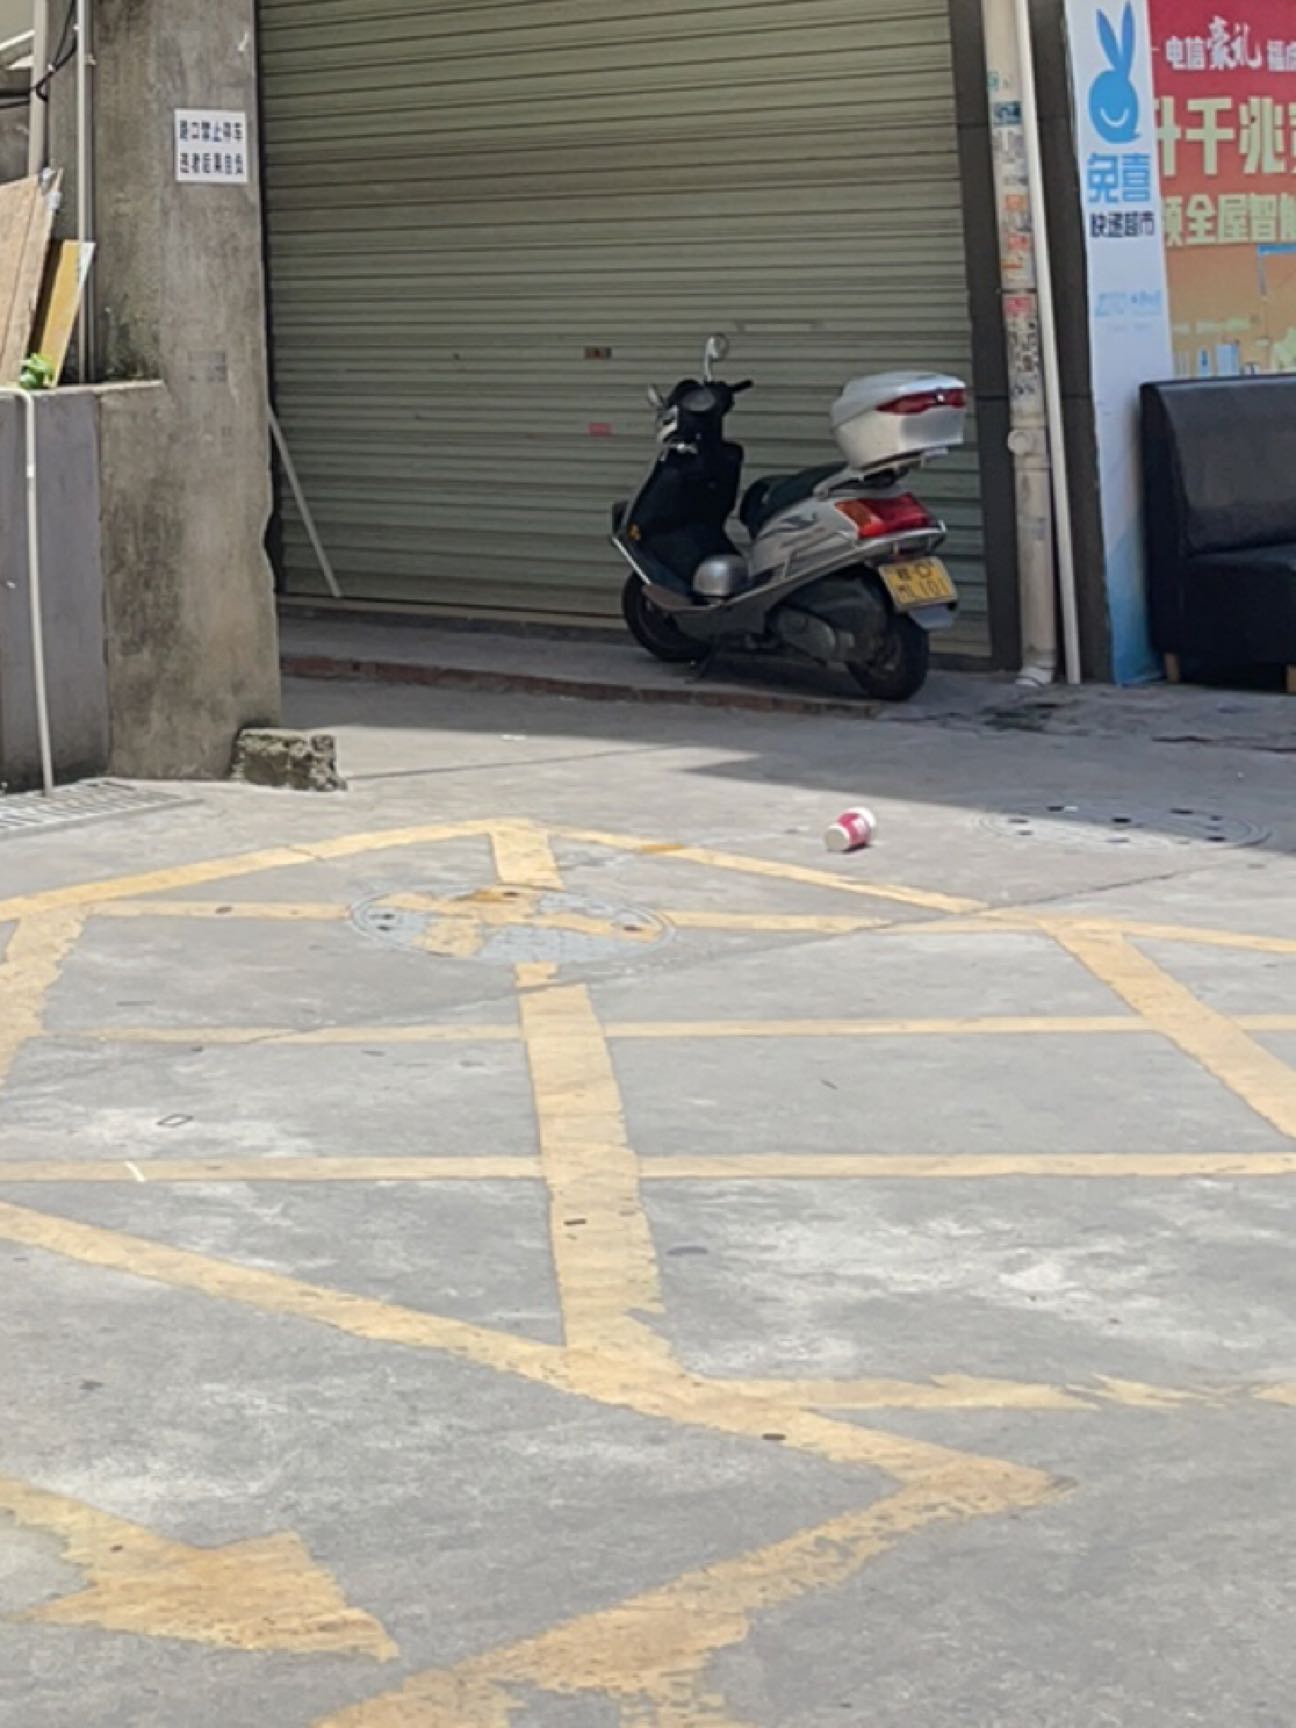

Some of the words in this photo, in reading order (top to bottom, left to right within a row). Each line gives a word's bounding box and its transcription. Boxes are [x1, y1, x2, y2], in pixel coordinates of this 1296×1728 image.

[1165, 15, 1263, 71] 电信豪礼
[1156, 95, 1296, 176] 升千兆
[1090, 210, 1155, 238] 快递超市
